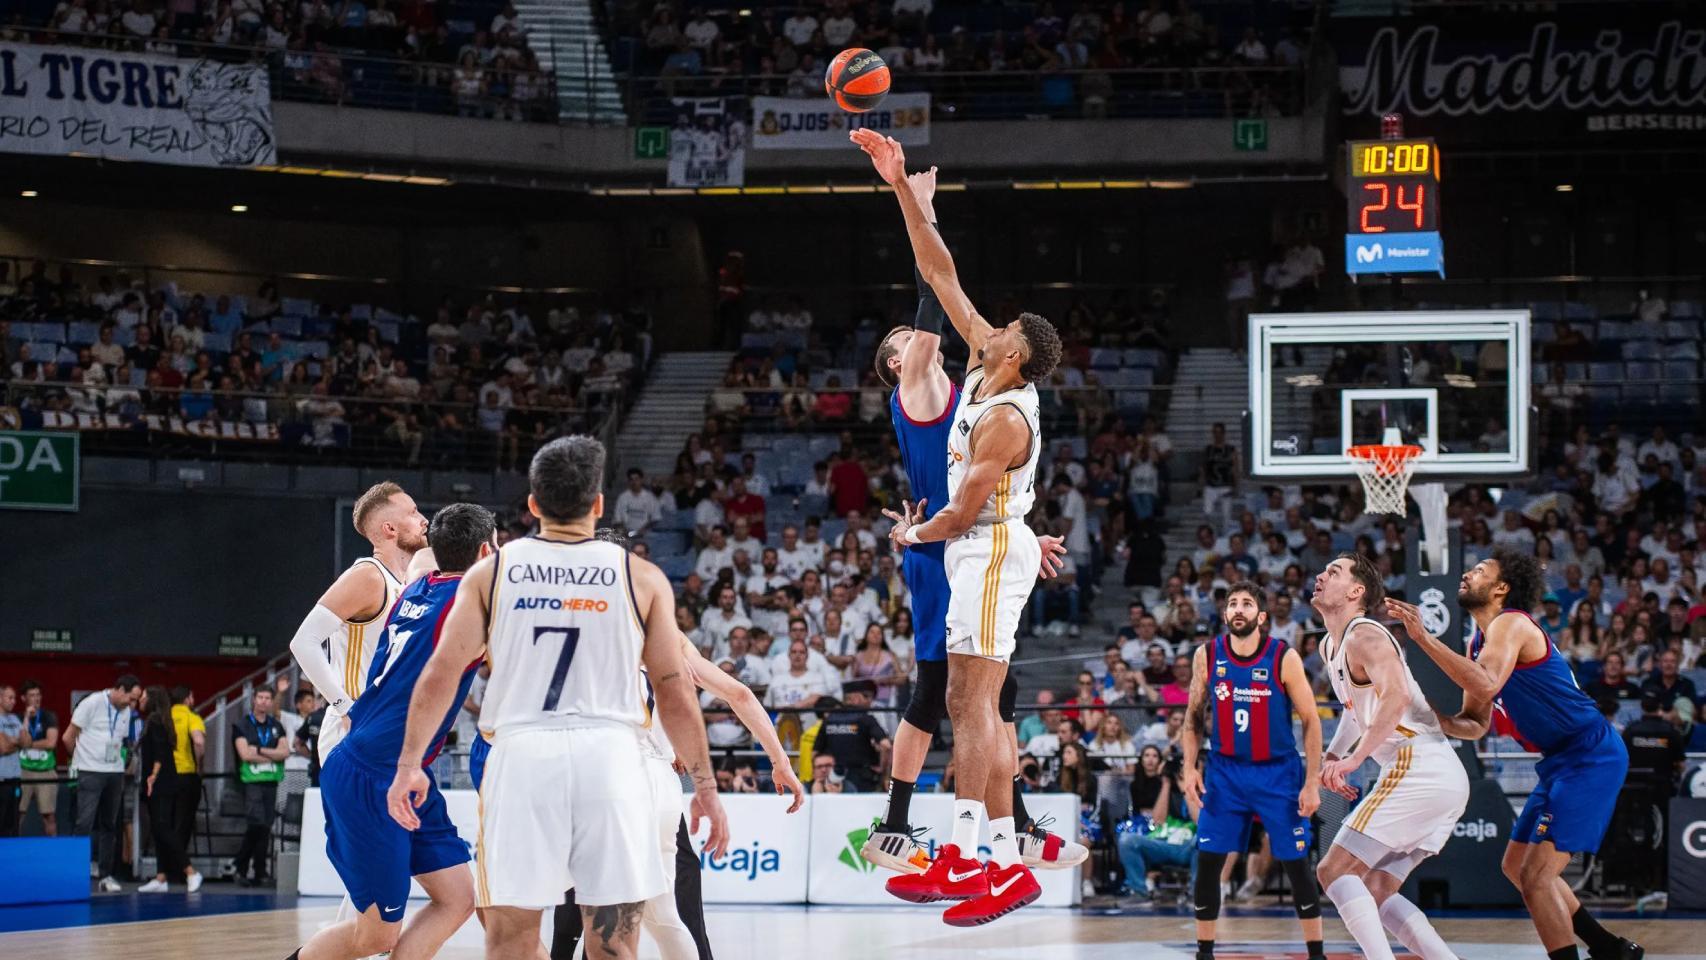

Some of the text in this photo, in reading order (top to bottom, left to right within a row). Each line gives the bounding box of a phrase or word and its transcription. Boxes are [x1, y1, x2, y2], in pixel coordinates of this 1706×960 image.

[1, 51, 183, 110] L TIGRE
[780, 112, 829, 131] OJOS
[58, 116, 121, 145] DEL
[123, 123, 205, 154] REAL
[1363, 144, 1429, 173] 10:00
[1361, 183, 1423, 232] 24
[1387, 246, 1431, 257] Movistar
[508, 564, 616, 587] CAMPAZZO
[514, 598, 609, 613] AUTOHERO
[533, 626, 580, 711] 7
[1235, 709, 1249, 732] 9
[1453, 818, 1498, 842] caja
